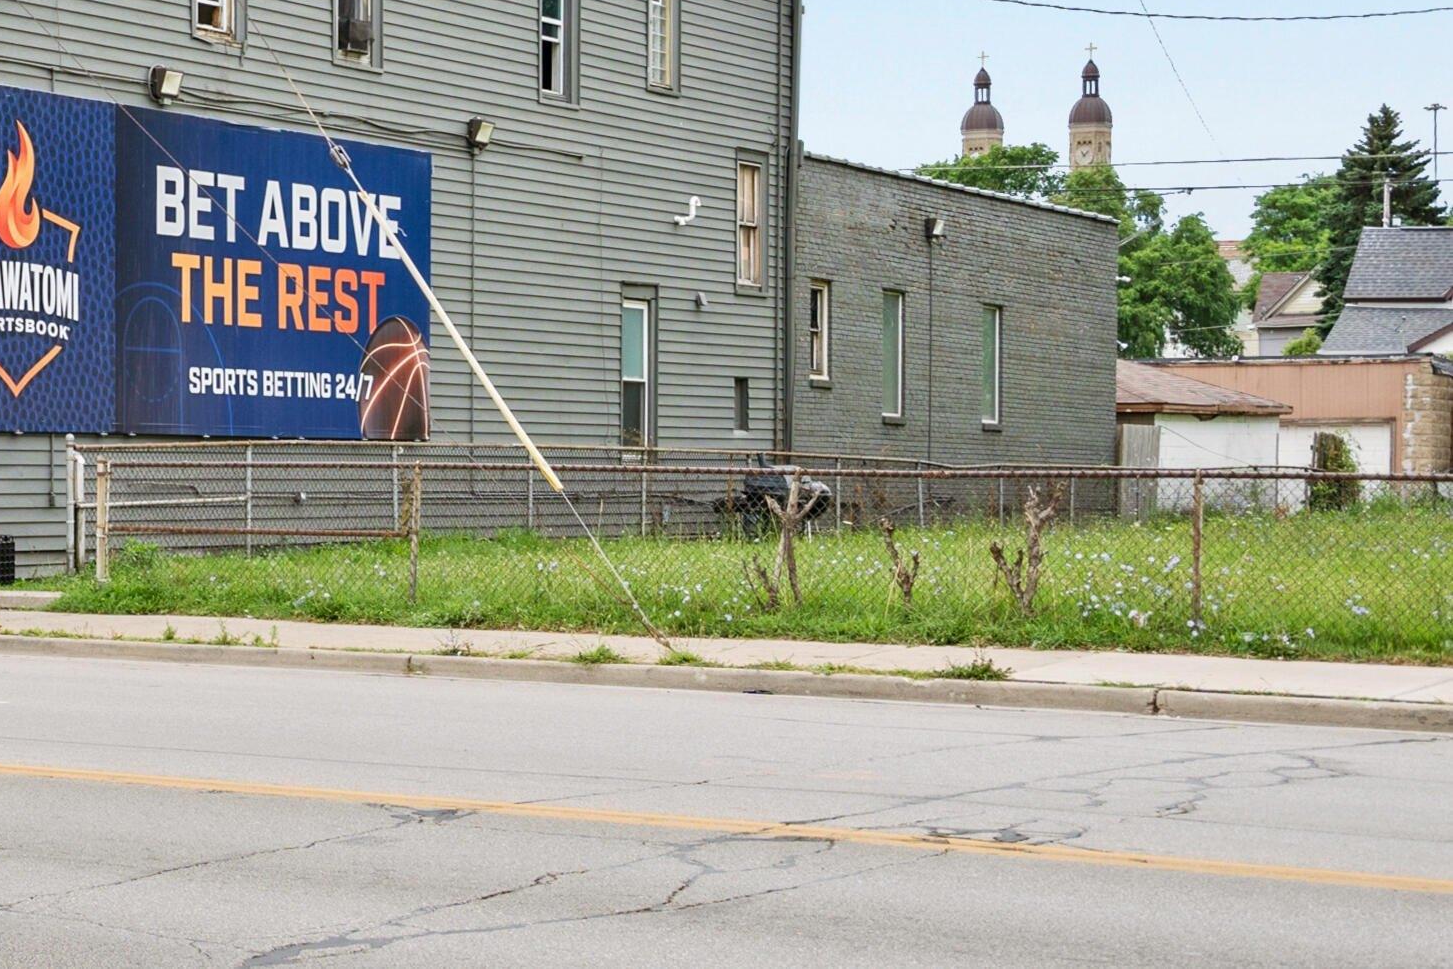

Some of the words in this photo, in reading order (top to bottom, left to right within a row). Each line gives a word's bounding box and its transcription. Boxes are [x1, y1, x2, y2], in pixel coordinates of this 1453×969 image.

[156, 165, 245, 243] BET
[257, 180, 402, 260] ABOVE
[171, 252, 262, 328] THE
[278, 262, 385, 336] REST
[188, 366, 258, 396] SPORTS
[262, 370, 332, 399] BETTING
[335, 372, 374, 402] 24/7
